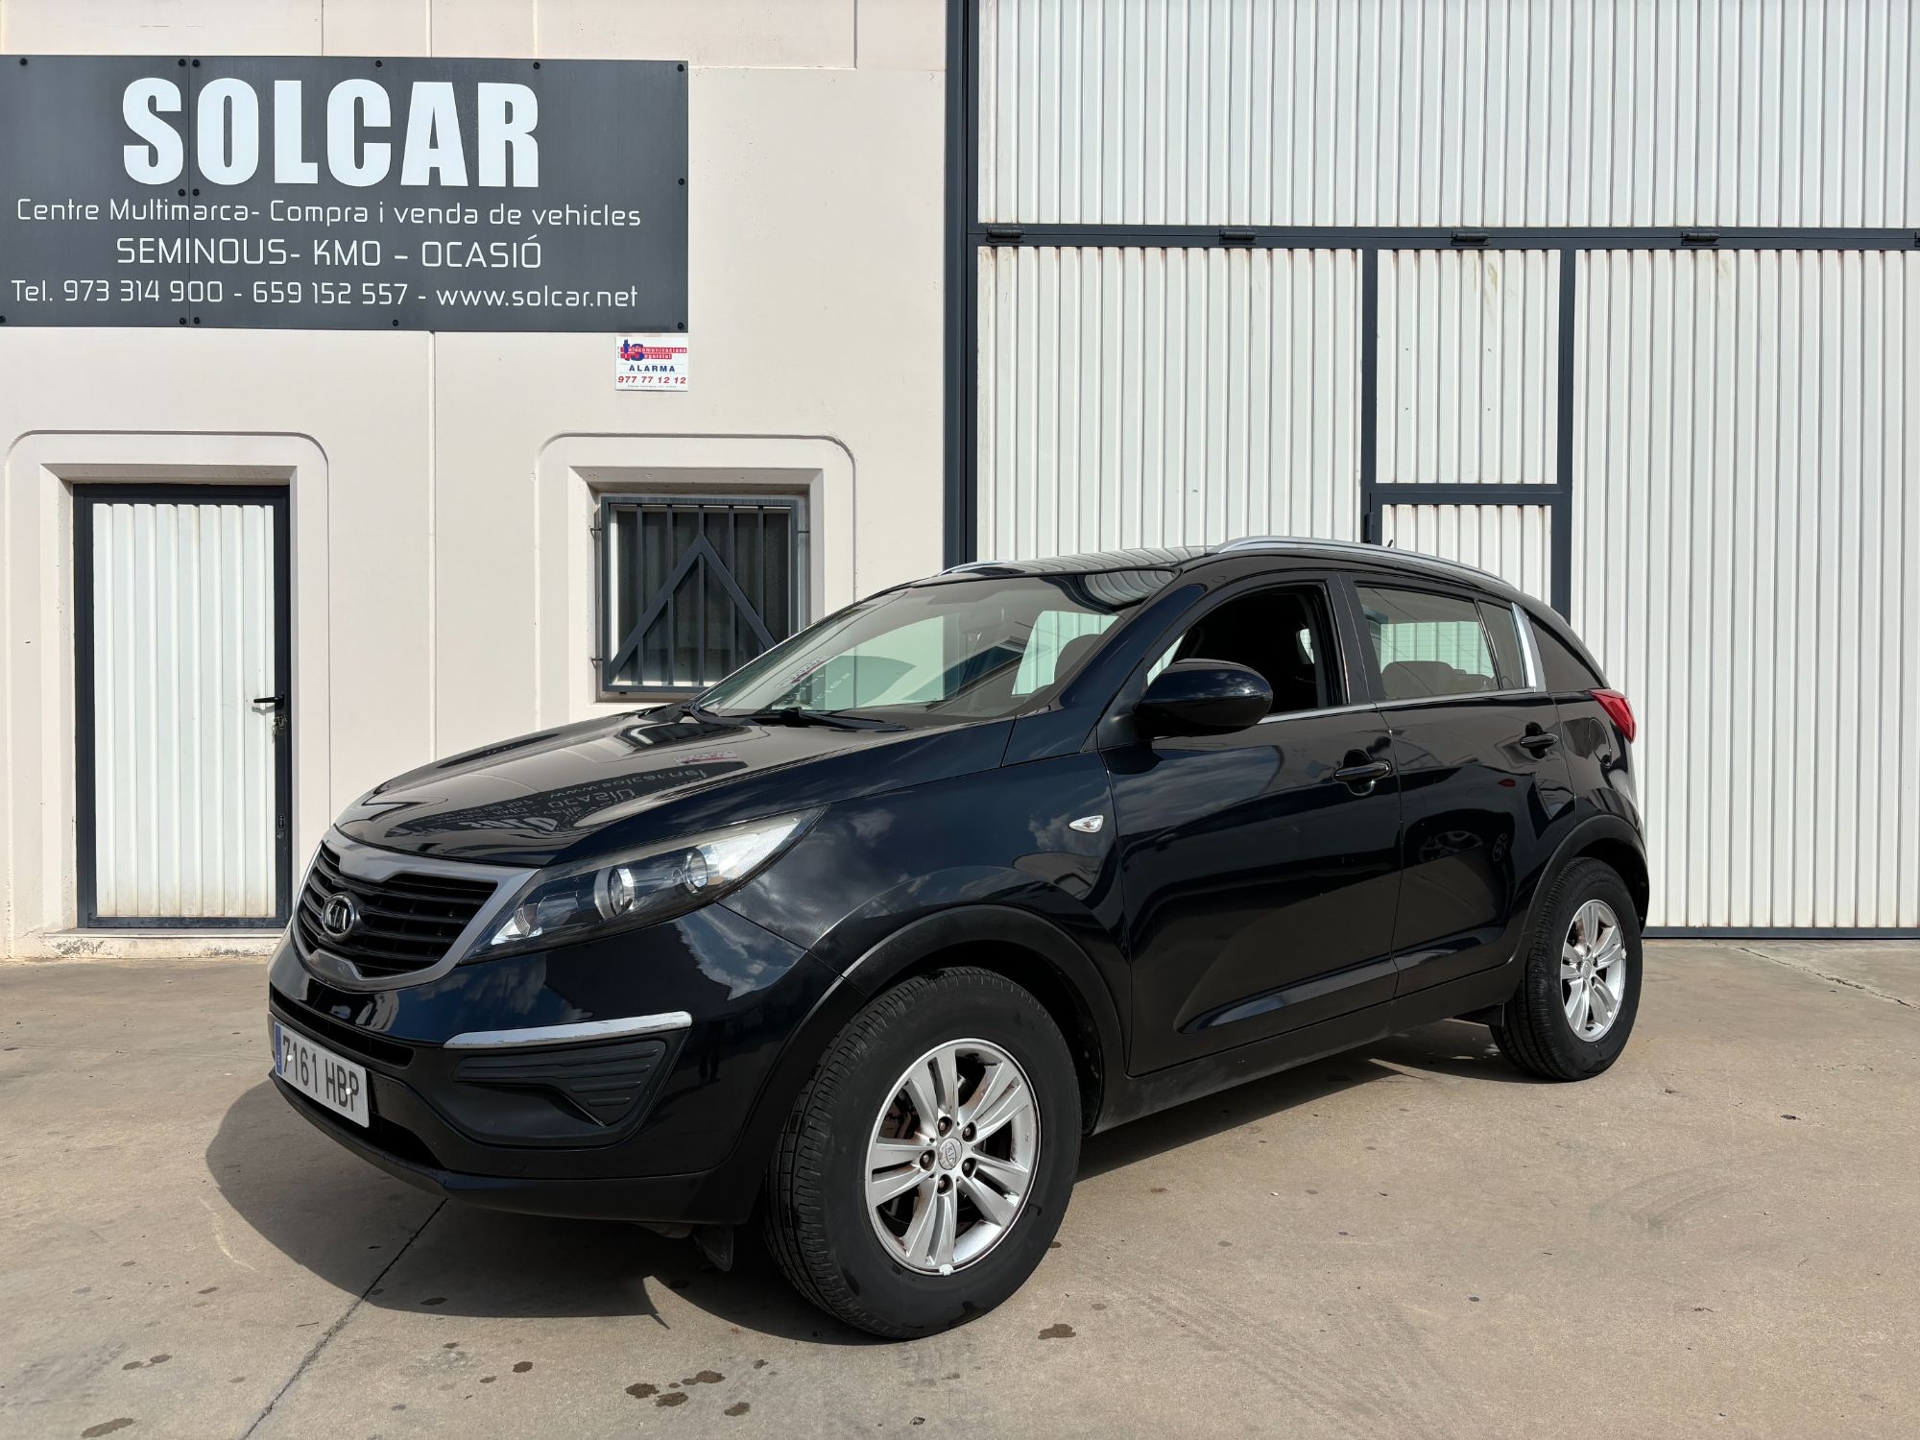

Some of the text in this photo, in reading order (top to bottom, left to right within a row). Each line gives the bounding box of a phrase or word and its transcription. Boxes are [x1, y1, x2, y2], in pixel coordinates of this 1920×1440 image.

[122, 76, 540, 188] SOLCAR
[17, 197, 642, 228] Centre Multimarca- Compra i venda de vehicles
[116, 236, 301, 266] SEMINOUS-
[421, 233, 542, 269] OCASIÓ
[10, 279, 54, 303] Tel.
[63, 279, 110, 303] 973
[120, 279, 160, 303] 314
[169, 280, 223, 304] 900
[252, 280, 302, 304] 659
[311, 281, 352, 305] 152
[362, 281, 408, 306] 557
[435, 284, 638, 308] www.solcar.net
[618, 375, 637, 383] 977
[658, 376, 670, 384] 12
[674, 376, 687, 384] 12
[282, 1035, 360, 1112] 7161 HBP
